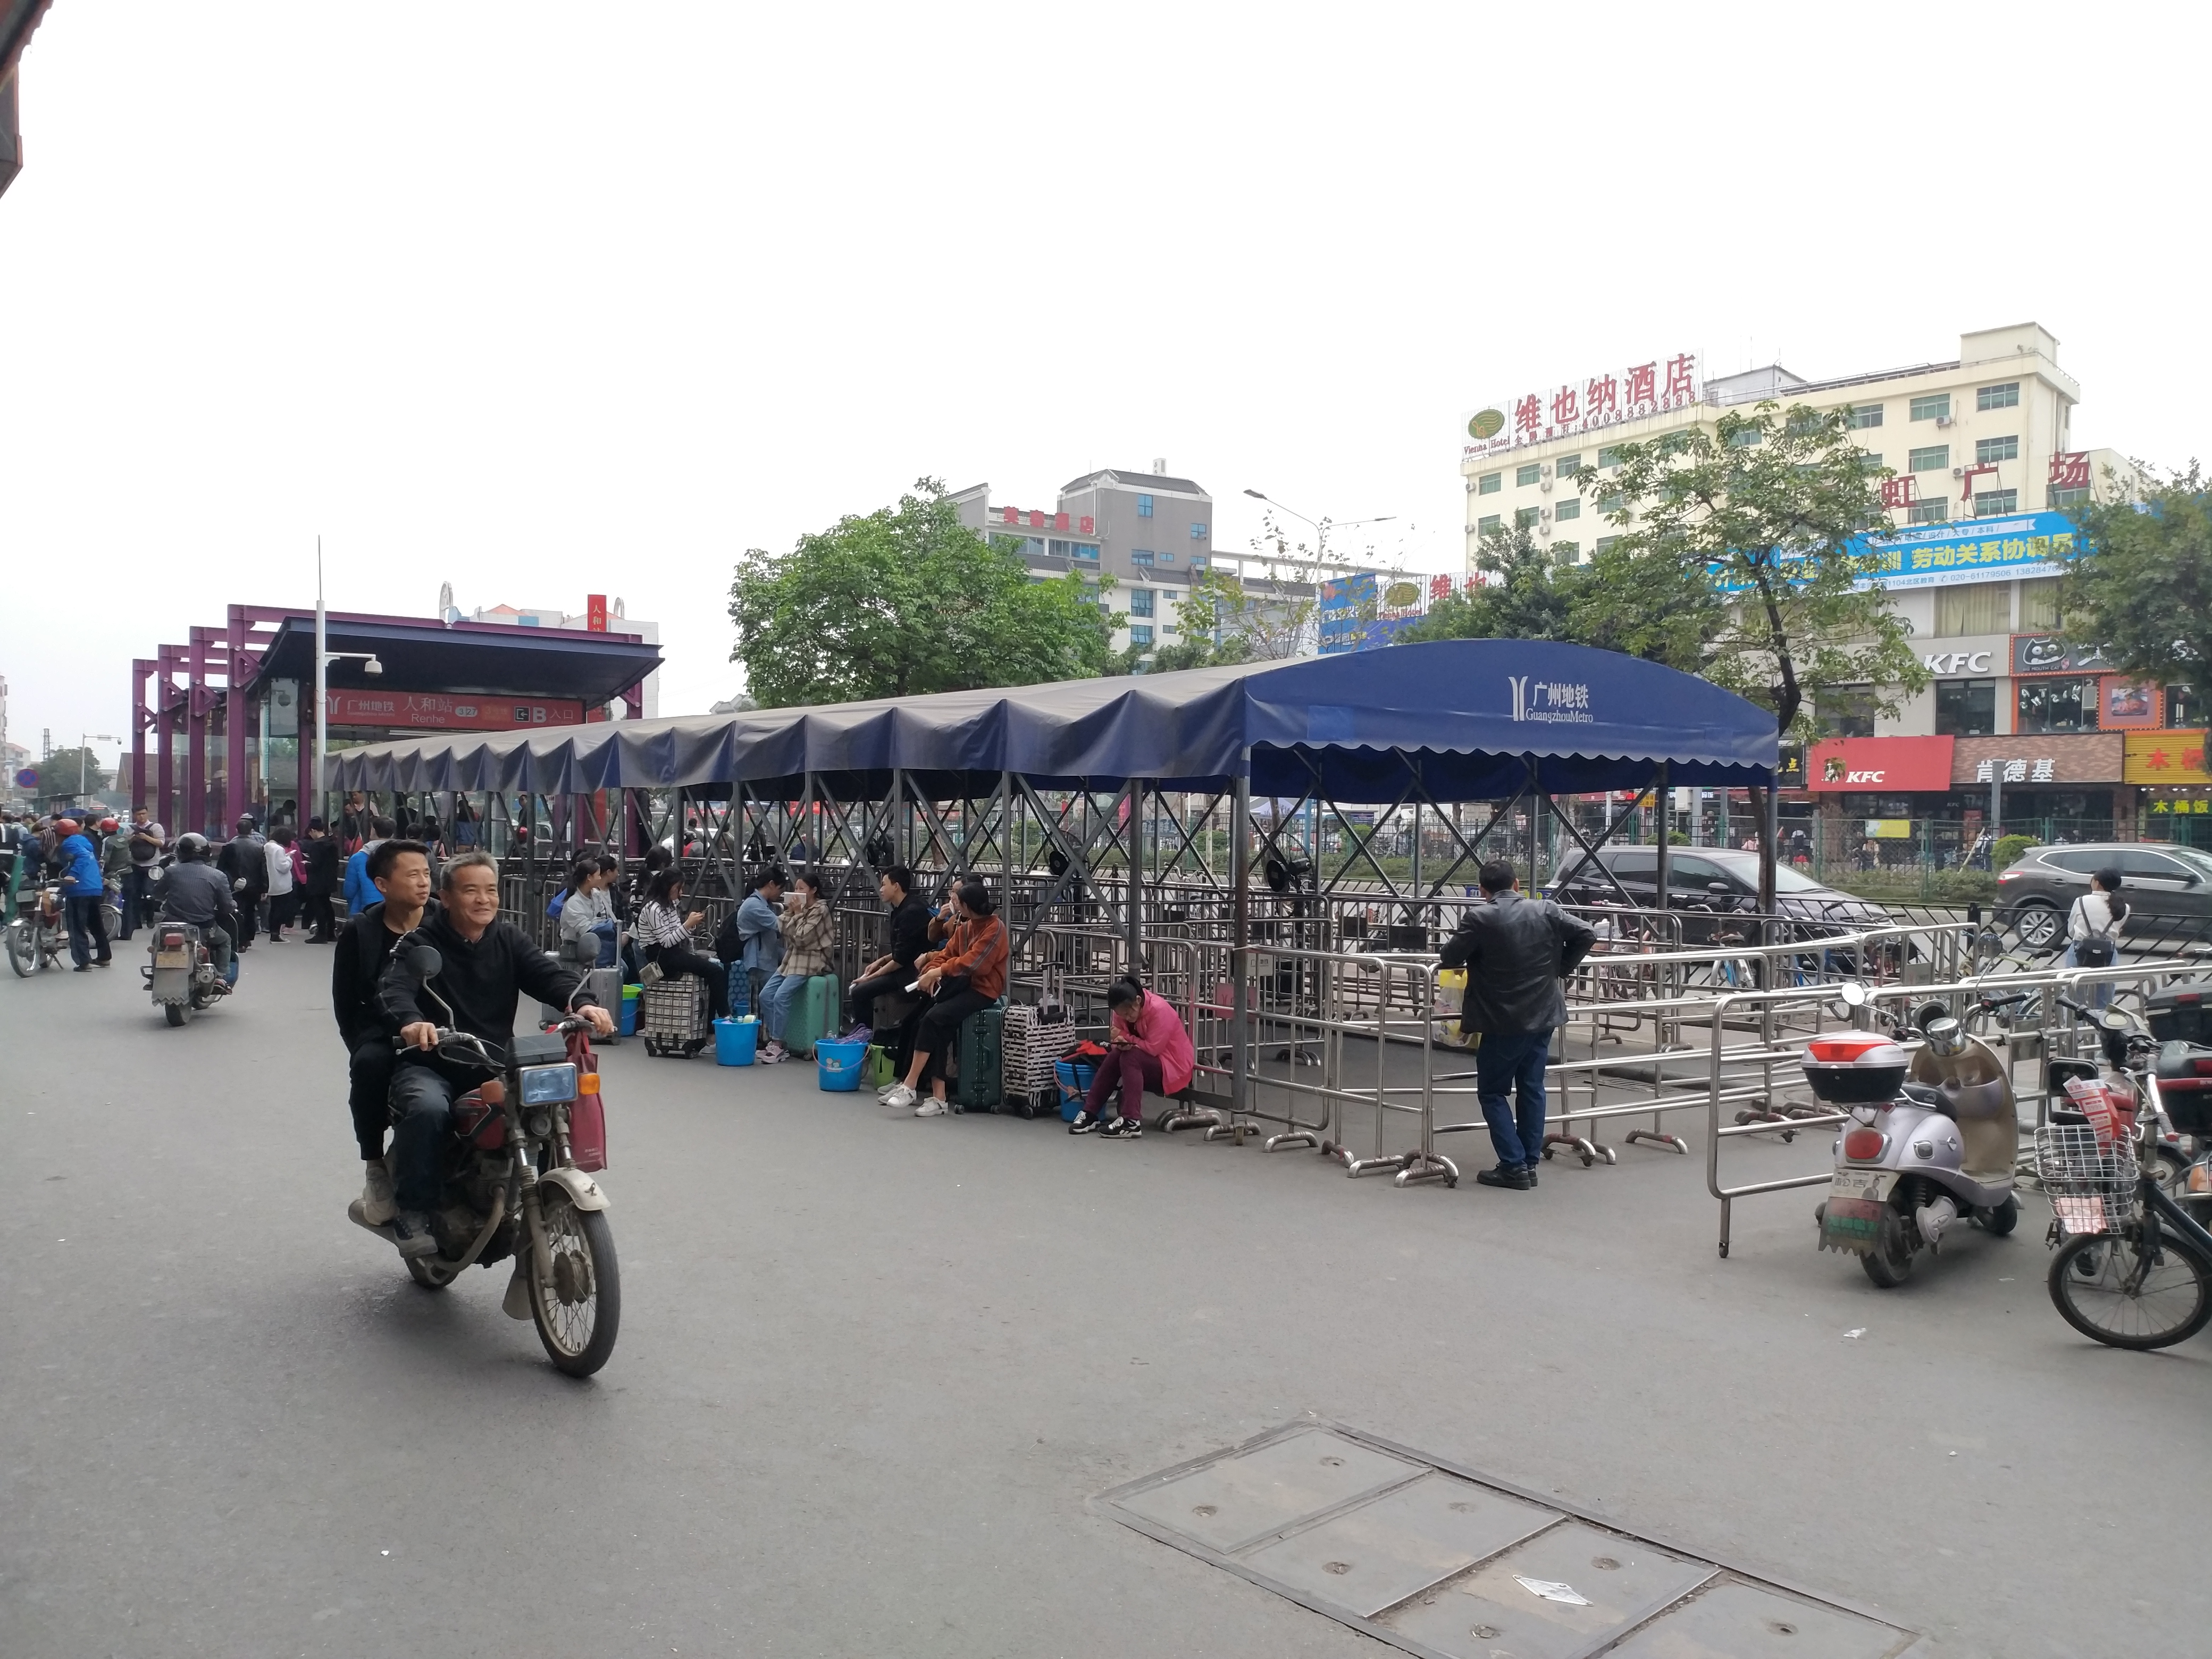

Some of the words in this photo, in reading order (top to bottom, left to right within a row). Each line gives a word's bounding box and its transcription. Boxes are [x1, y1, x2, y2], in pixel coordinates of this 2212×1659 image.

[1515, 353, 1696, 433] 维也纳酒店
[1464, 443, 1487, 455] Vienna
[1490, 436, 1510, 449] Hotel
[1950, 569, 2011, 582] 020-61179506
[2016, 564, 2061, 575] 13828476
[1924, 651, 1991, 674] KFC
[1533, 681, 1589, 709] 广州地铁
[347, 700, 395, 712] 广州地铁
[403, 696, 453, 713] 人和站
[533, 707, 547, 723] B
[549, 709, 573, 719] 入口
[412, 714, 445, 724] Renhe
[1846, 771, 1886, 783] KFC
[1977, 759, 2056, 783] 肯德基
[2153, 800, 2208, 814] 木桶饭
